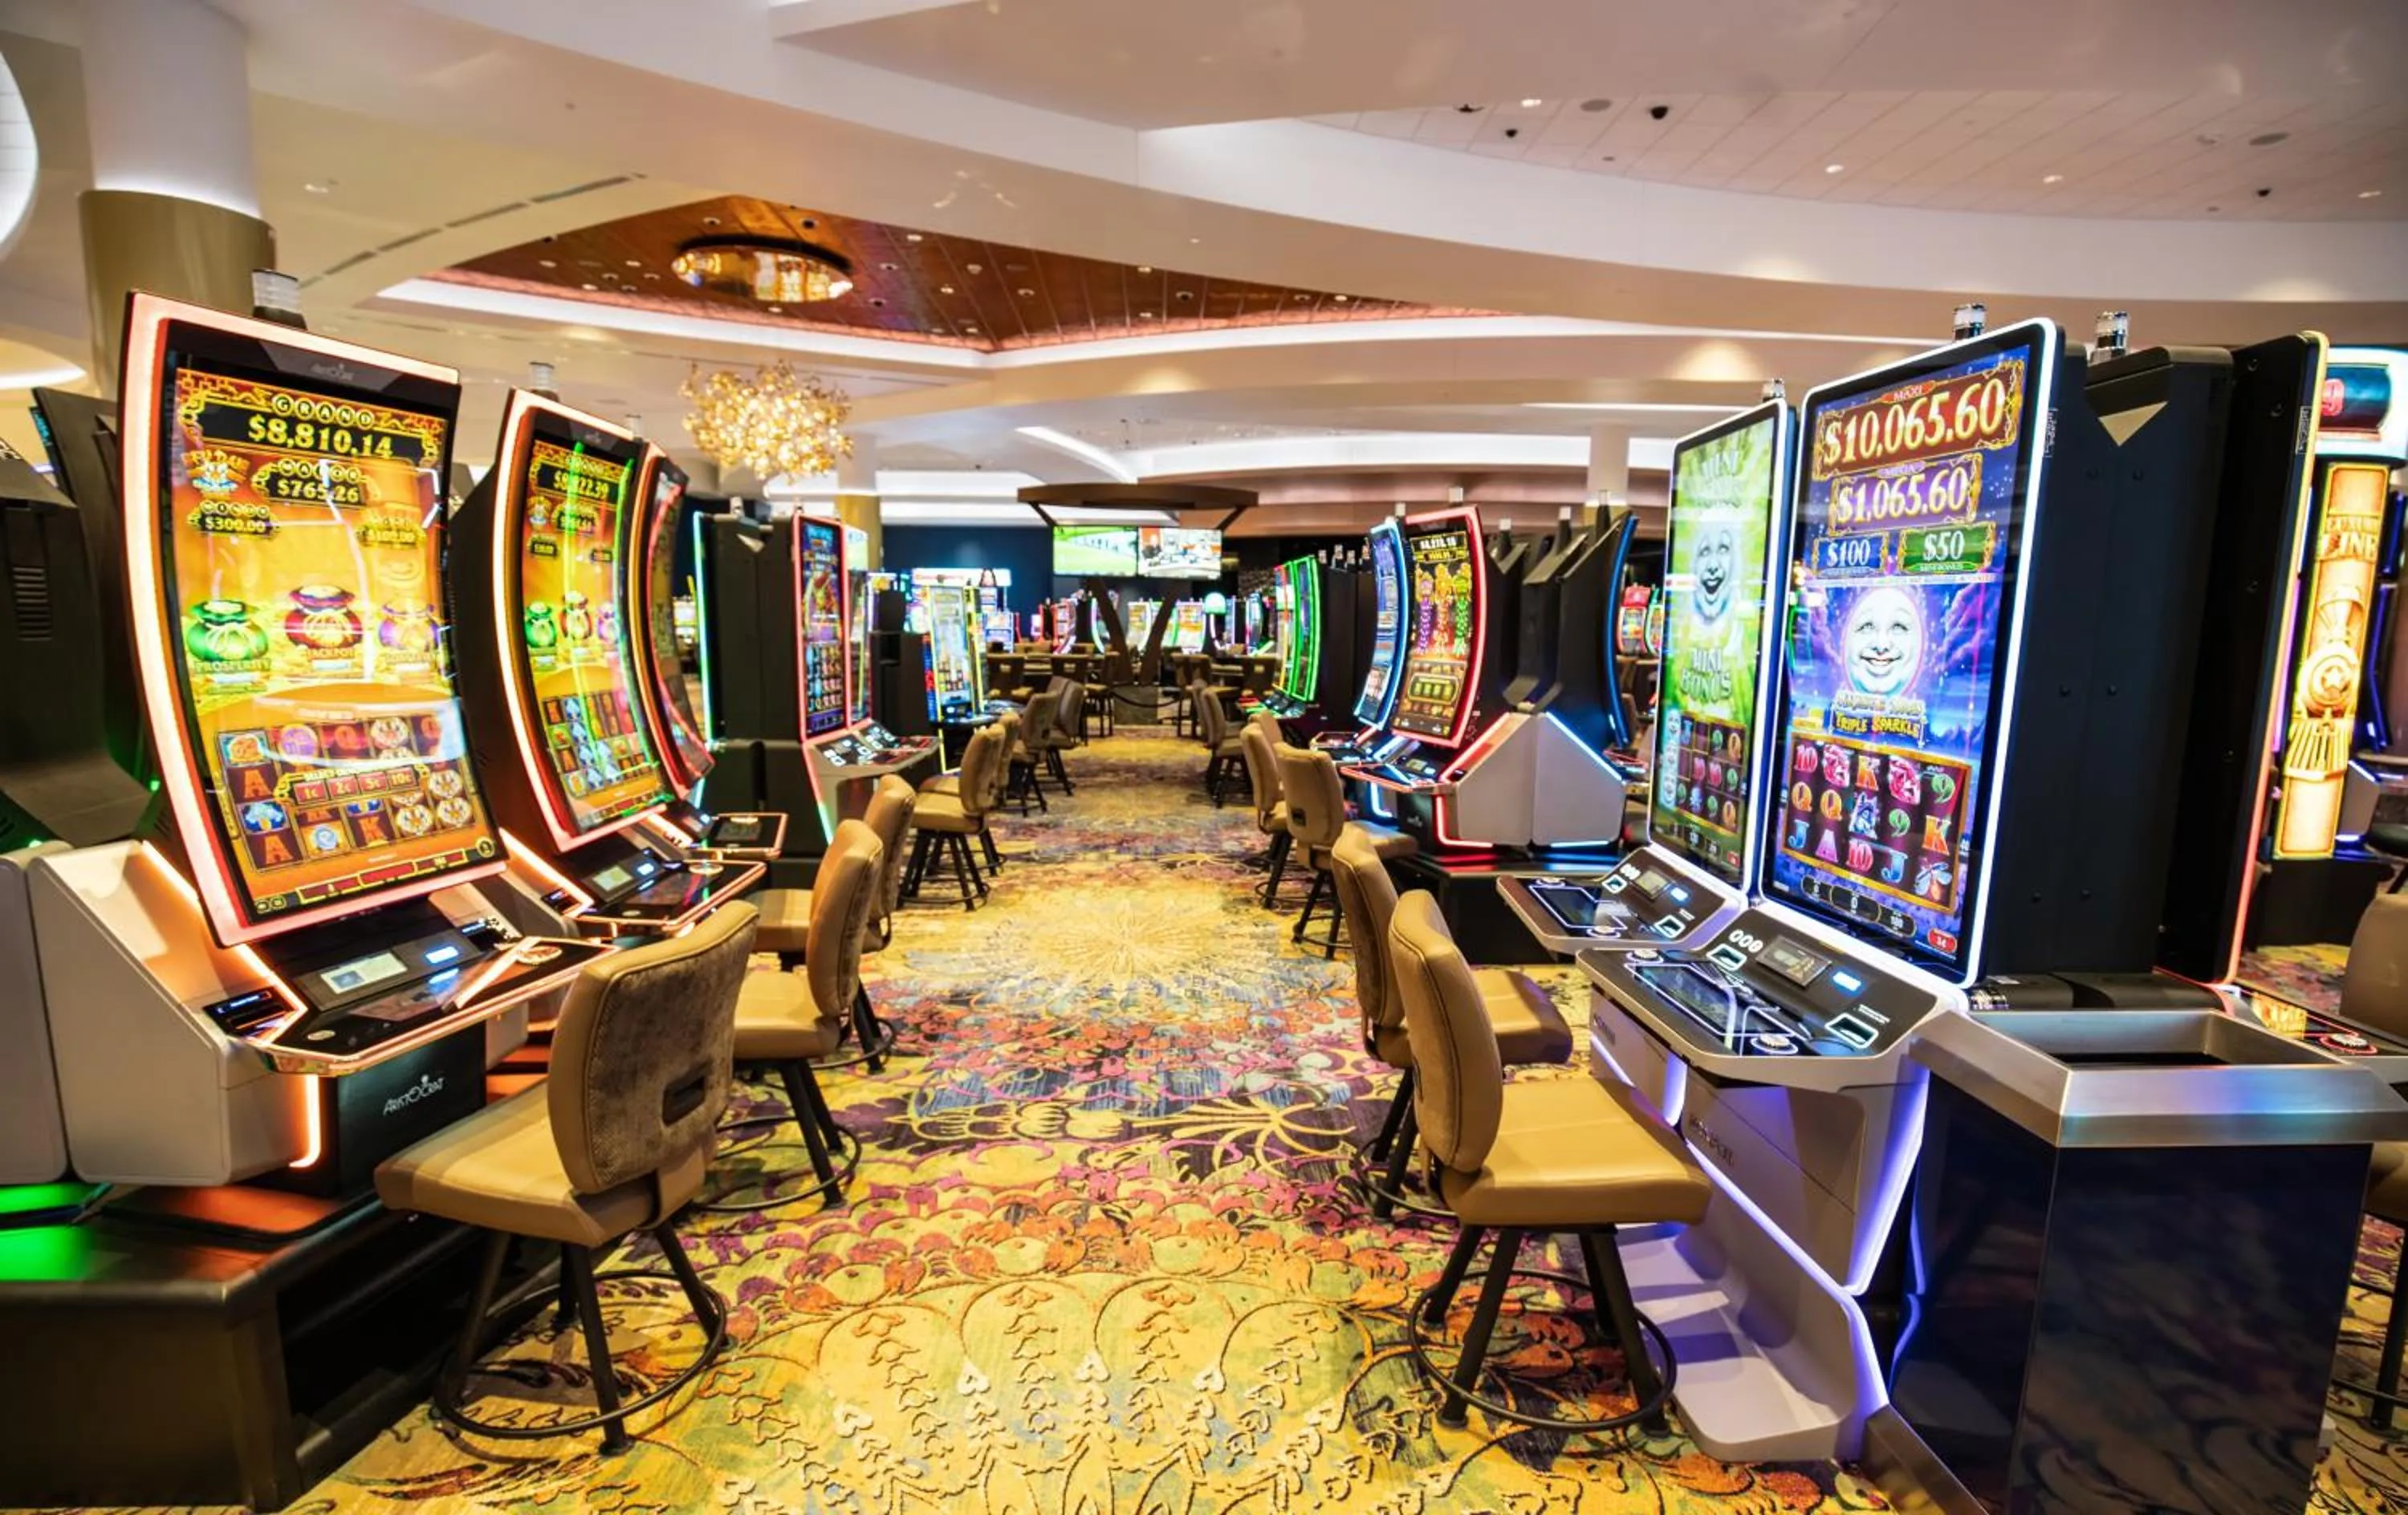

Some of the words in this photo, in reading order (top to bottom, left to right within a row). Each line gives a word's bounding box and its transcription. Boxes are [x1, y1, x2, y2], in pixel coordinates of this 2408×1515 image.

[1893, 384, 1923, 401] MAXI
[275, 396, 372, 426] GRAND
[1823, 378, 2005, 465] $10,065.60
[248, 415, 393, 459] $8,810.14
[277, 479, 360, 502] $765.26
[1837, 466, 1967, 524] $1,065.60
[1826, 538, 1871, 567] $100
[1923, 530, 1966, 563] $50
[1682, 668, 1732, 703] BONUS
[1872, 713, 1920, 739] SPARKLE
[243, 769, 272, 798] A
[1855, 755, 1881, 791] K
[1931, 773, 1956, 804] 9
[1791, 782, 1812, 812] Q
[1820, 789, 1843, 821] Q
[1889, 807, 1911, 837] 9
[1922, 814, 1951, 856] K
[264, 835, 295, 865] A
[1788, 818, 1810, 849] J
[1815, 828, 1839, 863] A
[1881, 849, 1909, 883] J
